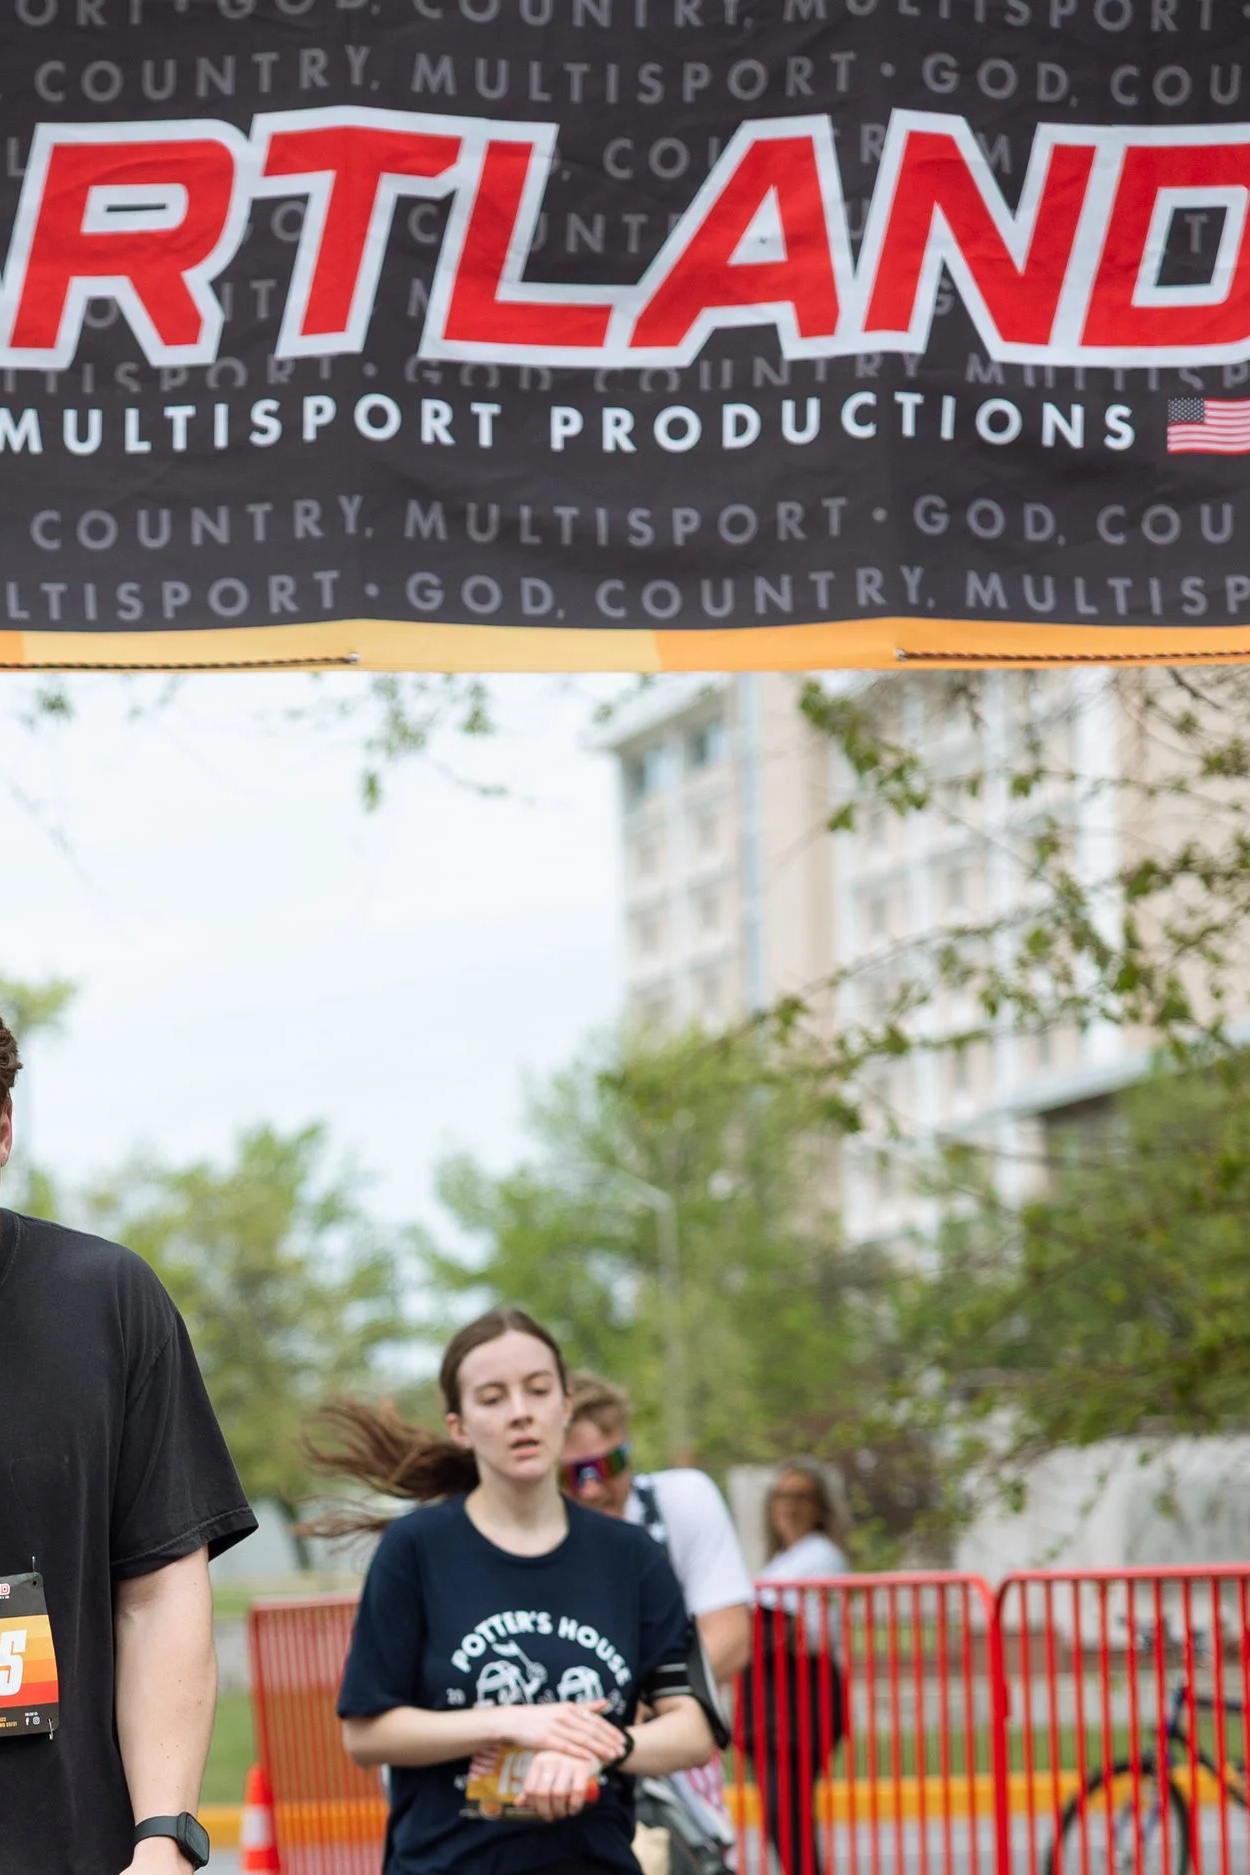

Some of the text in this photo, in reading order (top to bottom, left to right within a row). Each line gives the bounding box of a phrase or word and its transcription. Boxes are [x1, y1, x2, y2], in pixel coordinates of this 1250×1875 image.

[34, 46, 380, 102] COUNTRY,
[411, 51, 857, 104] MULTISPORT
[922, 53, 1079, 108] GOD,
[549, 391, 1137, 453] PRODUCTIONS
[29, 495, 375, 550] COUNTRY,
[404, 496, 847, 548] MULTISPORT
[912, 494, 1067, 547] GOD,
[405, 571, 566, 621] GOD,
[596, 565, 936, 620] COUNTRY,
[451, 1610, 633, 1687] POTTER'S HOUSE
